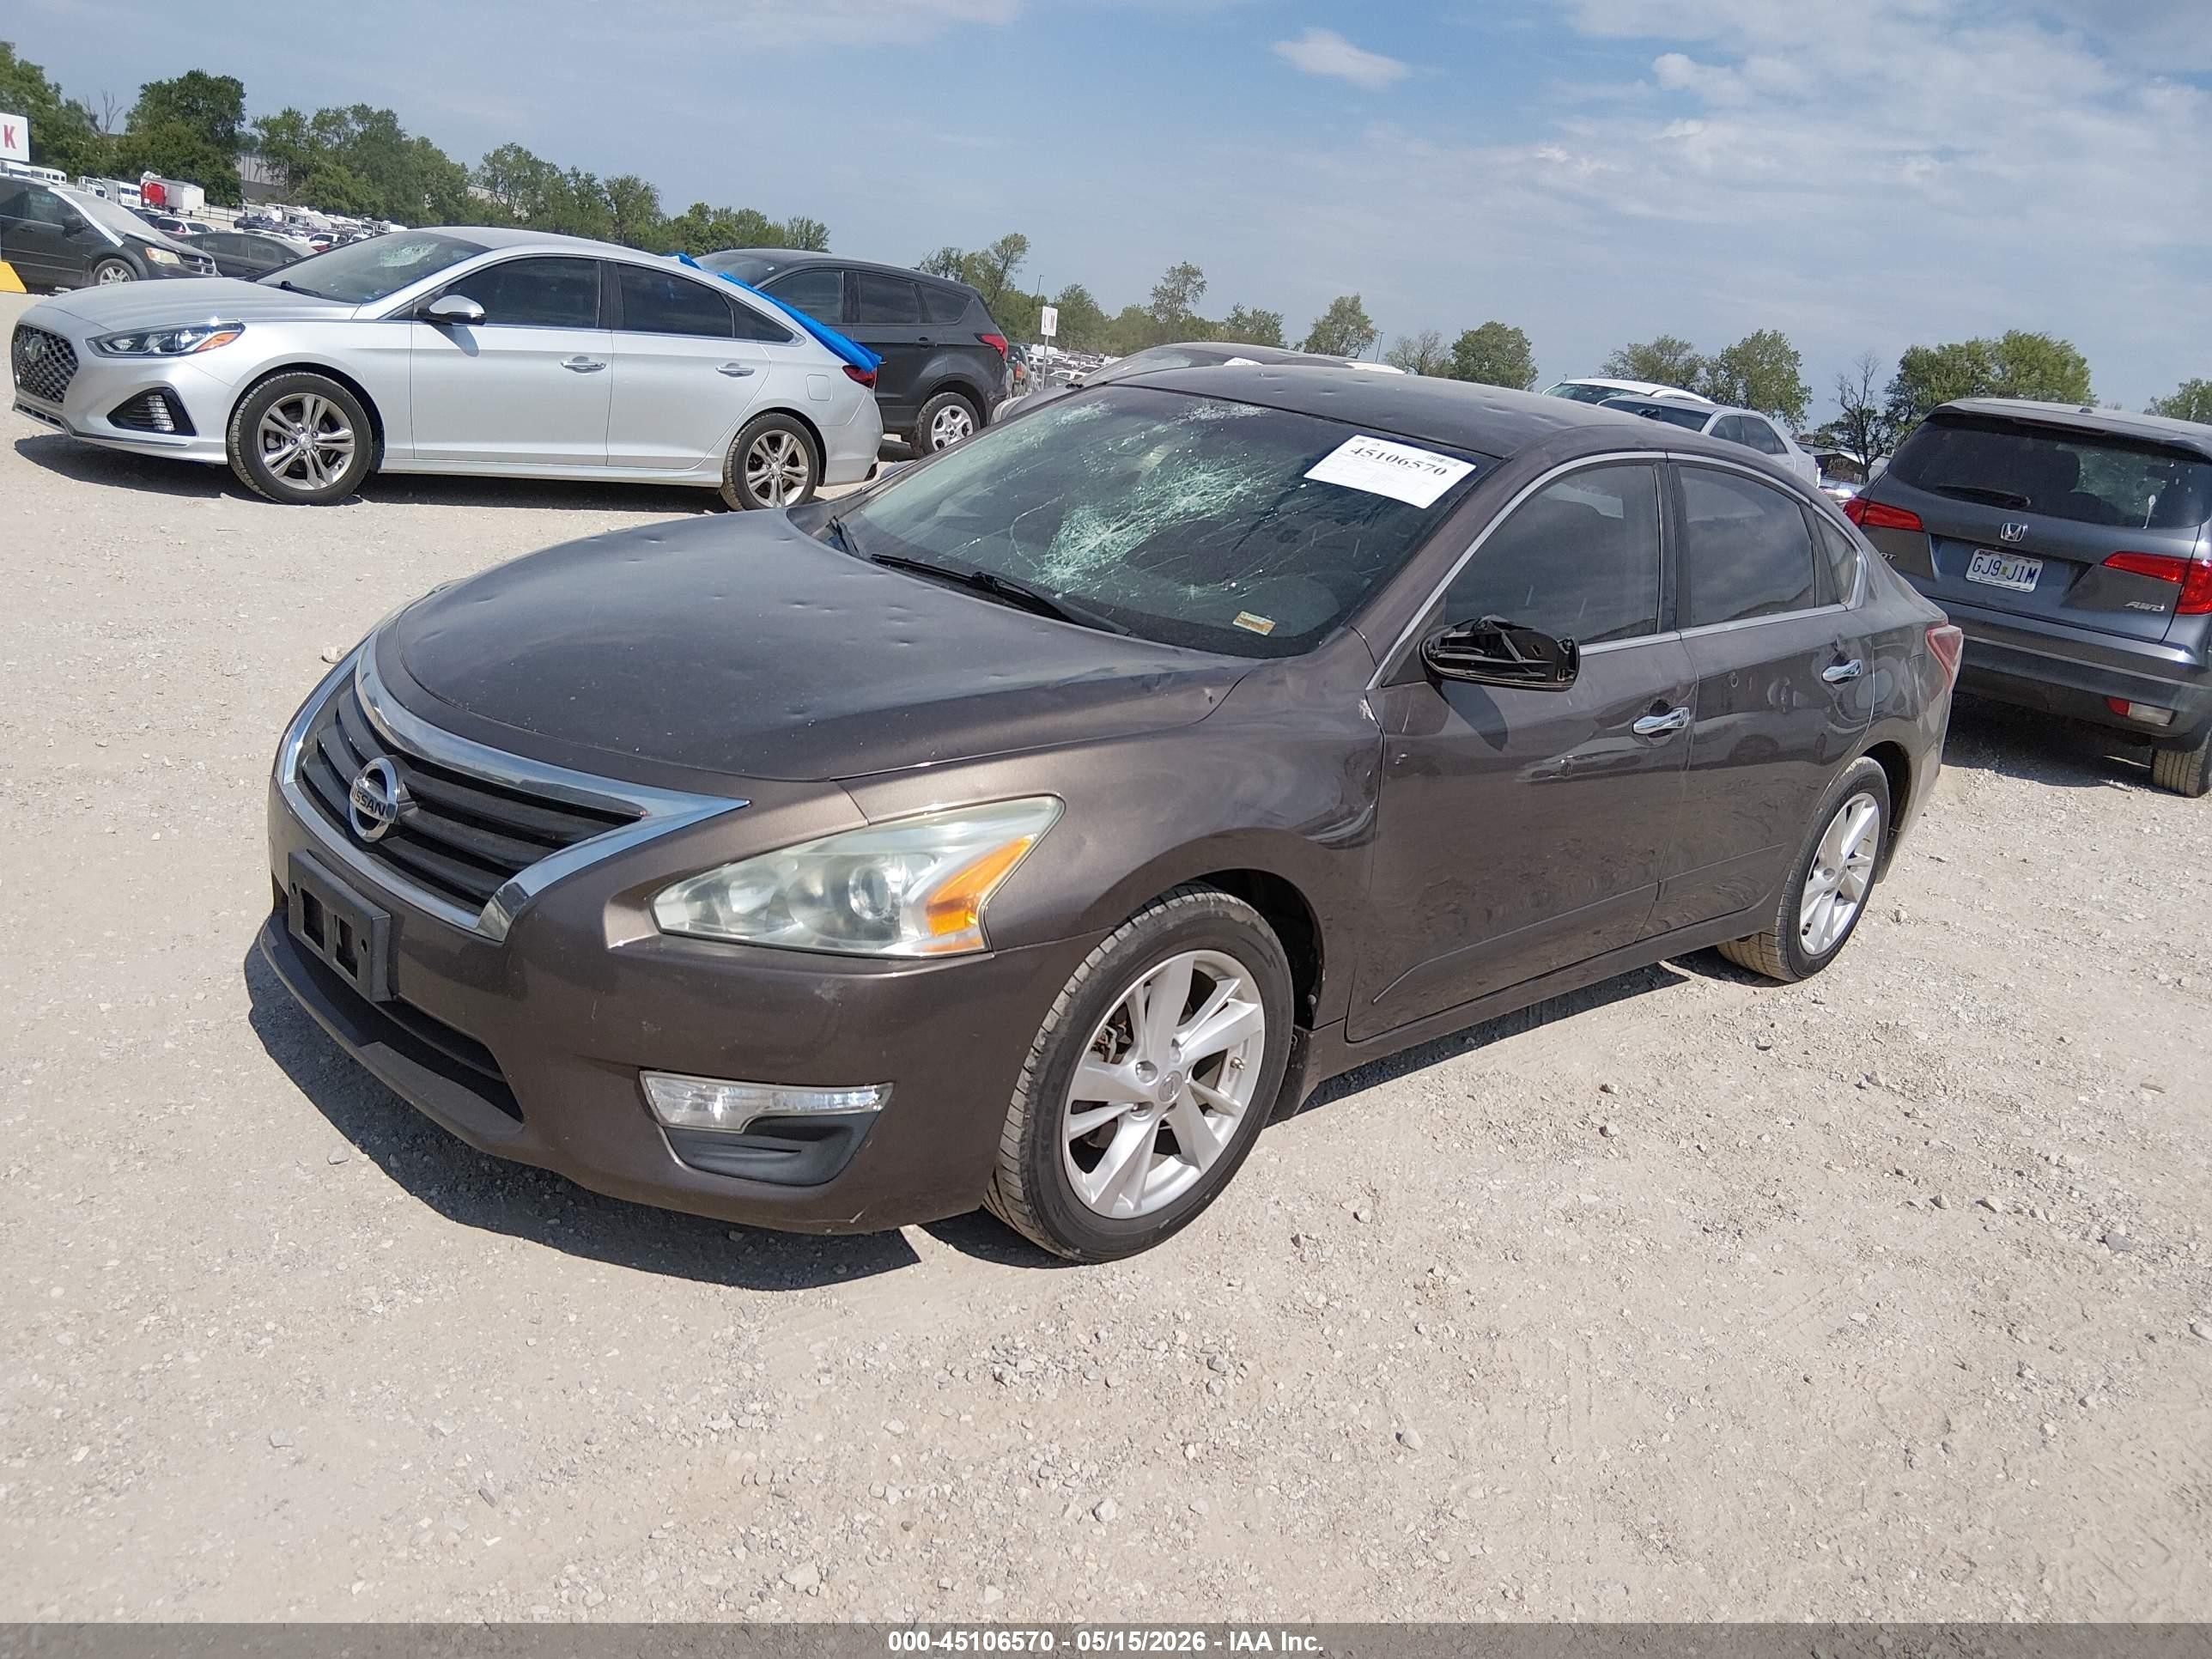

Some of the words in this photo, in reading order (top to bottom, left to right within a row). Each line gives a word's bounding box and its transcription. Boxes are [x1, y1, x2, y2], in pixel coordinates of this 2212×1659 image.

[4, 125, 16, 149] K
[1350, 447, 1447, 476] 45106570
[1972, 556, 2002, 576] GJ9
[2006, 564, 2038, 584] J1M
[2124, 601, 2165, 611] AWD
